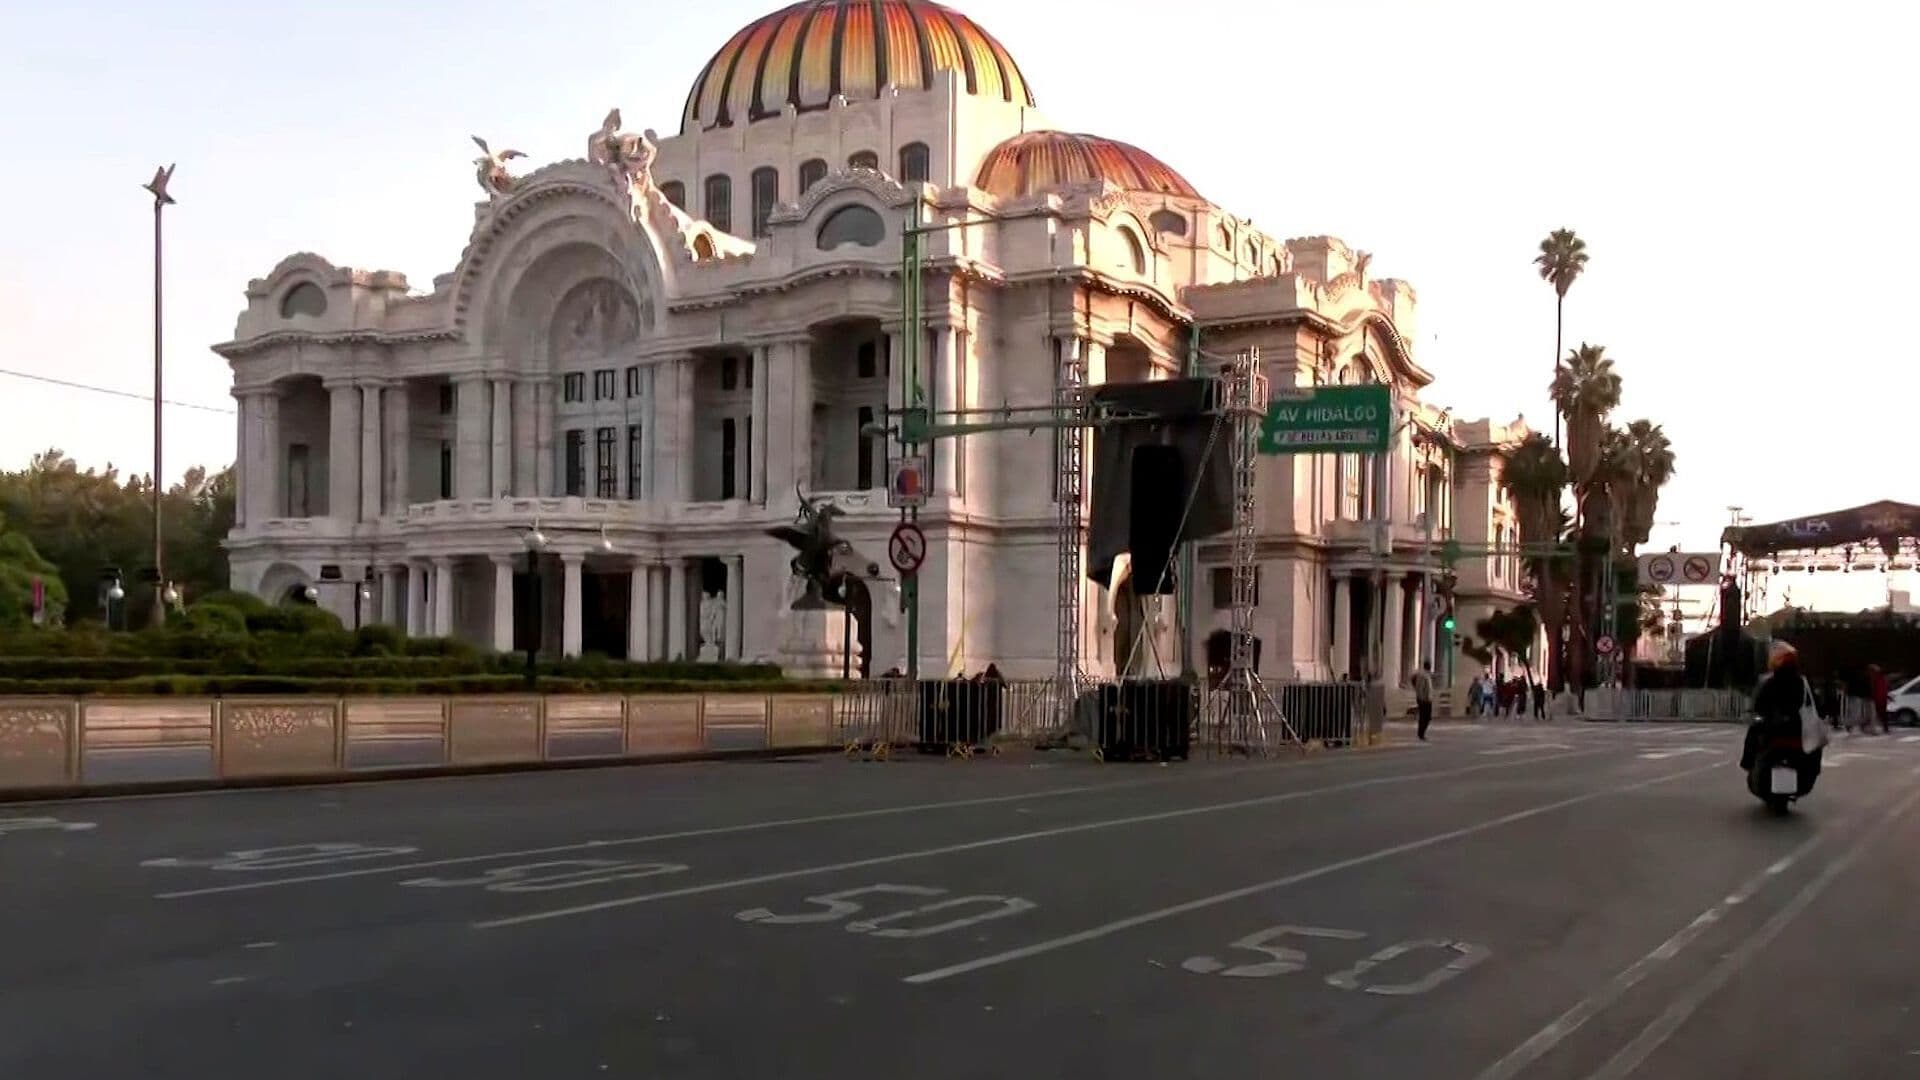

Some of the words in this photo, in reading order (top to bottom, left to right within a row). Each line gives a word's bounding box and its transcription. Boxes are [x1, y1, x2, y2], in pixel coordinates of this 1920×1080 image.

[1278, 407, 1299, 422] AV
[1306, 405, 1378, 422] HIDALGO
[1776, 518, 1832, 535] ALFA
[734, 884, 1039, 939] 50
[1181, 924, 1494, 995] 50
